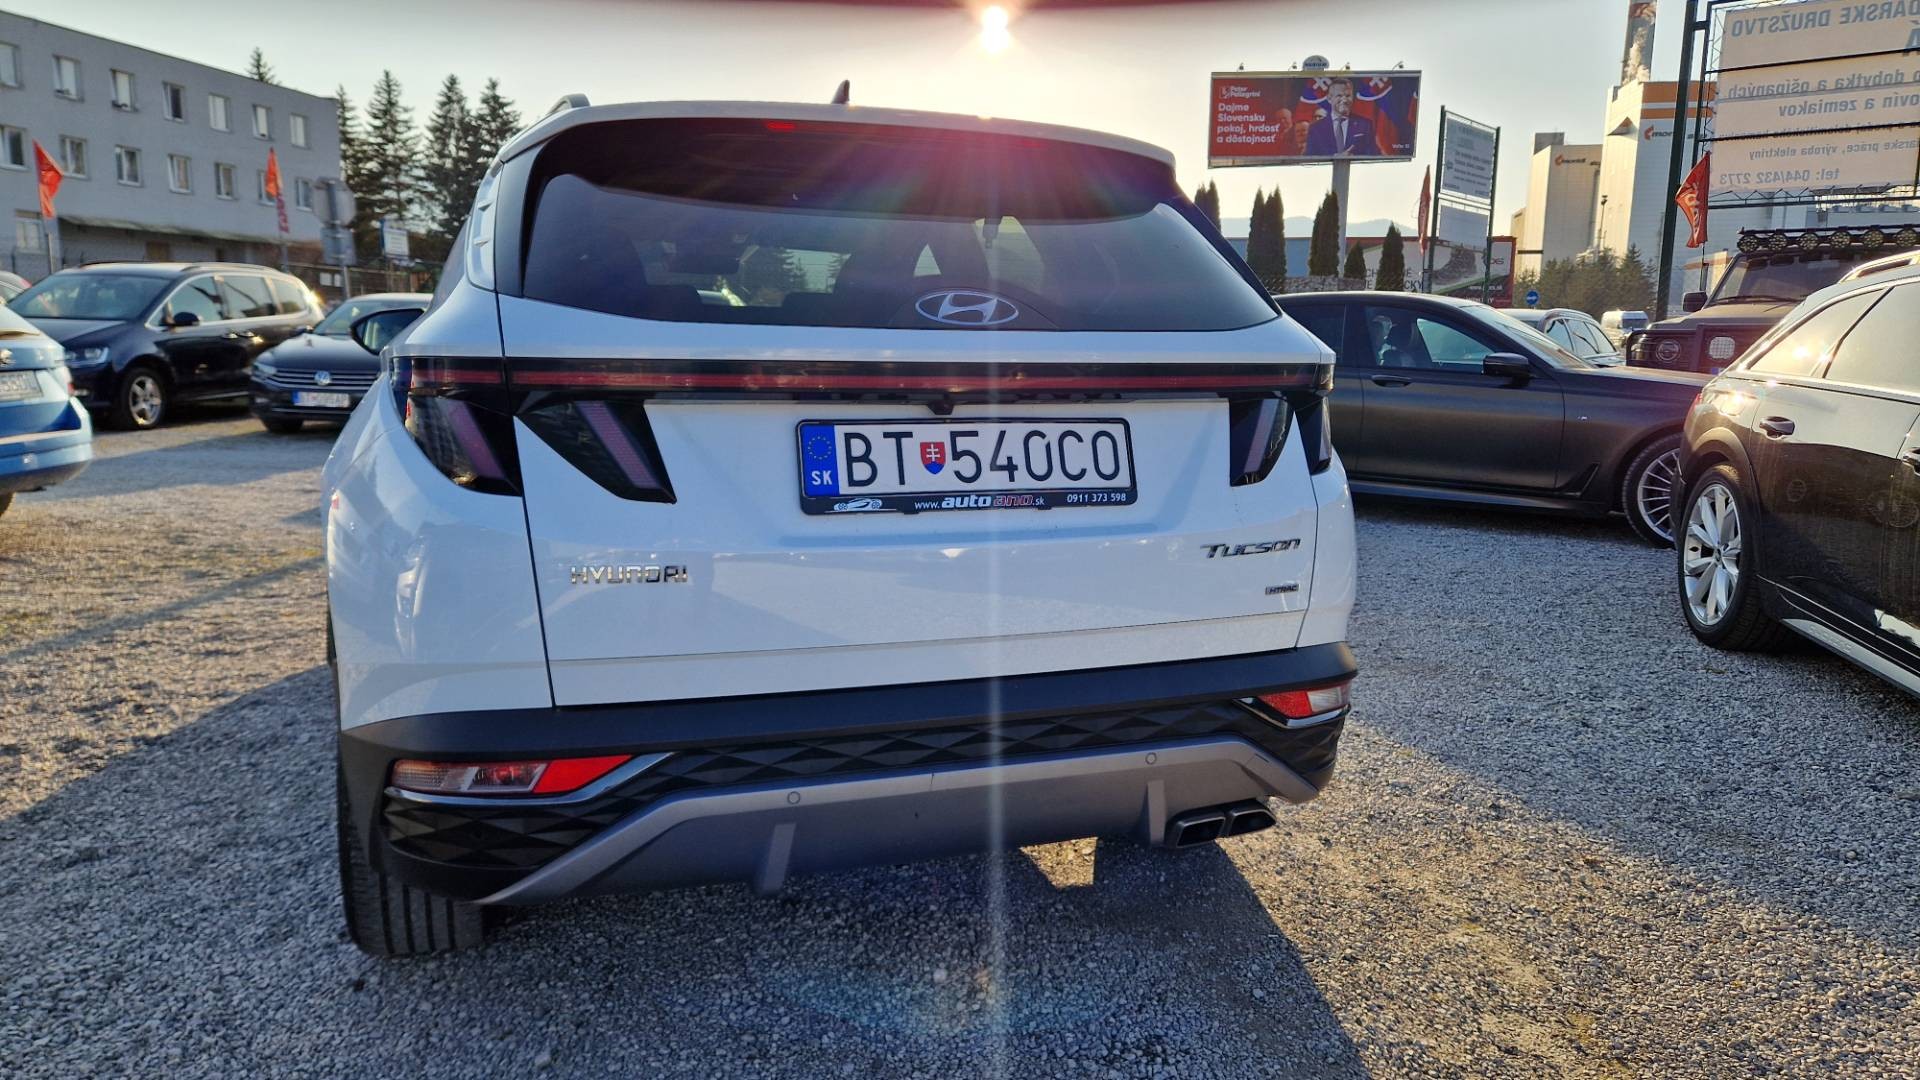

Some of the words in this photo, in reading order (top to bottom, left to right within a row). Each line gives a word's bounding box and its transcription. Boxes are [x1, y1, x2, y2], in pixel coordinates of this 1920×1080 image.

[1217, 103, 1249, 114] Dajme
[1217, 113, 1266, 122] Slovensku
[1216, 123, 1247, 134] pokoj,
[1248, 123, 1281, 132] hrdosť
[844, 431, 913, 487] BT
[811, 470, 833, 486] SK
[1066, 493, 1089, 503] 0911
[1091, 493, 1108, 502] 373
[1110, 492, 1127, 502] 598
[571, 565, 688, 584] HYUNDAI
